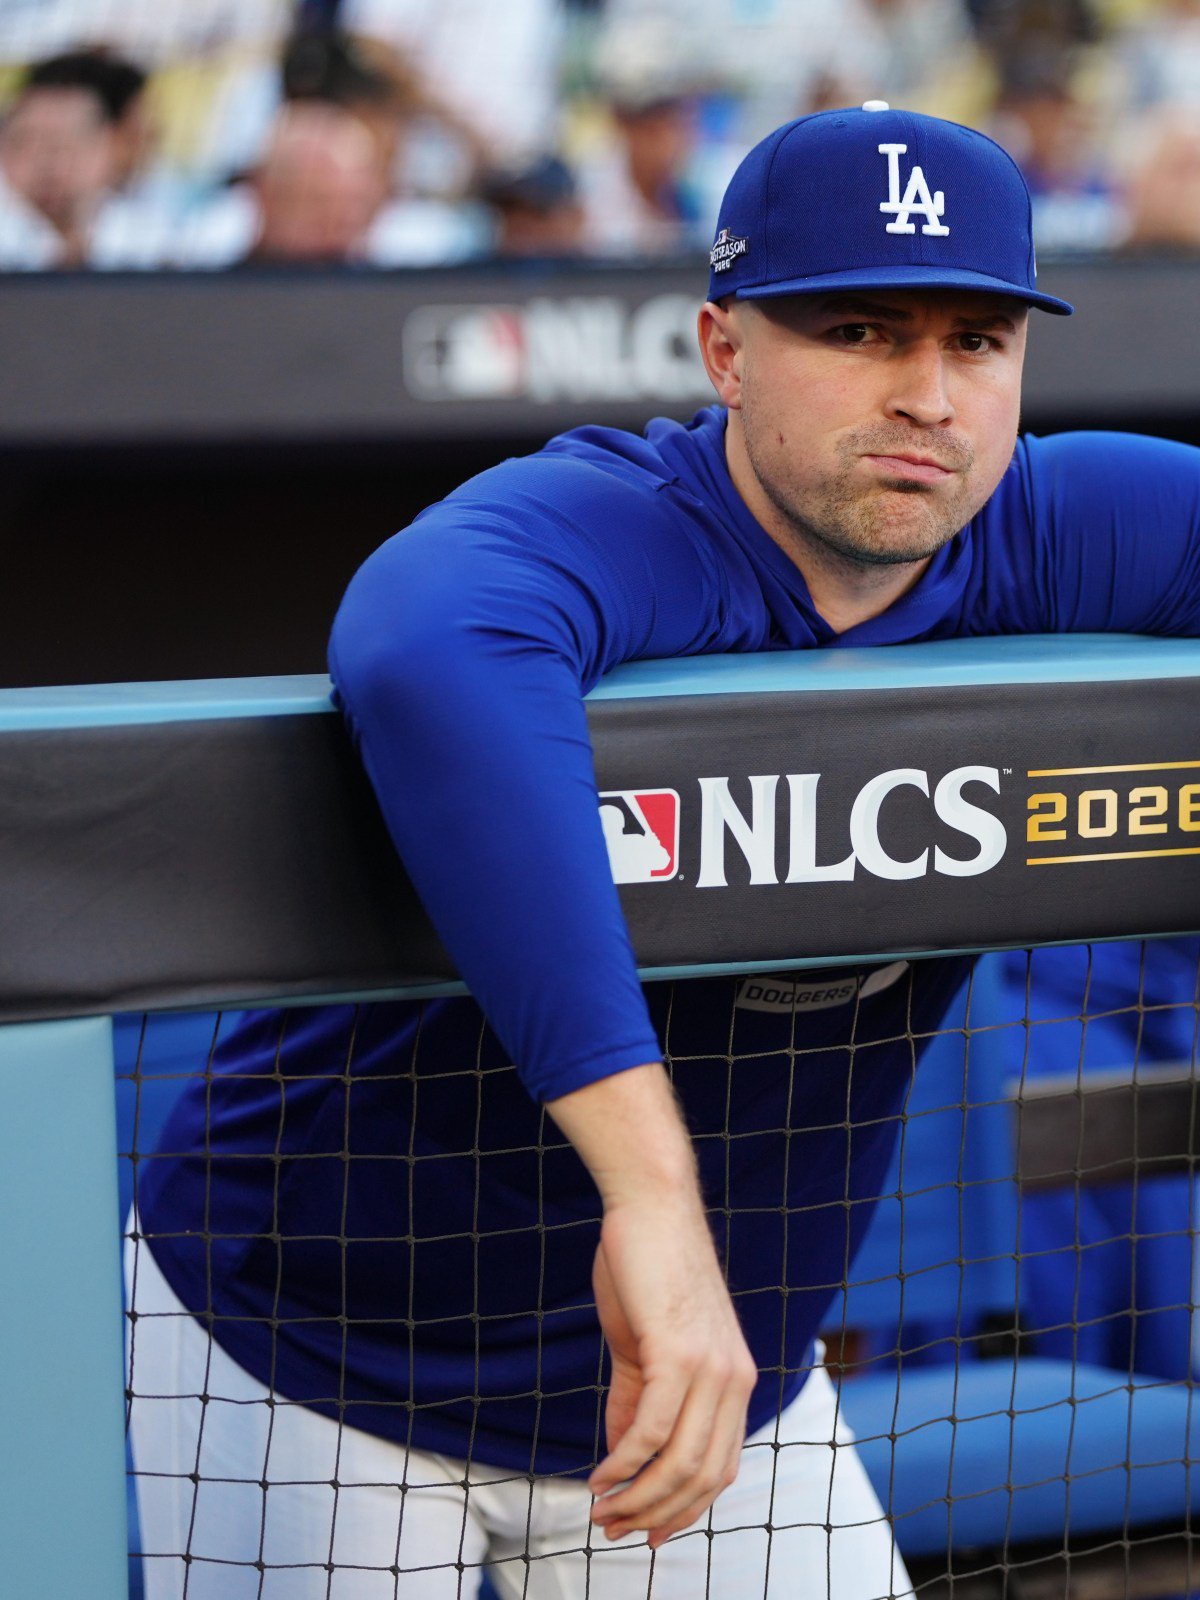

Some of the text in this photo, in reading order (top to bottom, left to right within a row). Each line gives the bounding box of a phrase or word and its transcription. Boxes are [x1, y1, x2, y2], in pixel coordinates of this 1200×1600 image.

[878, 143, 950, 236] LA
[710, 240, 746, 264] OSTSEASON
[695, 765, 1007, 888] NLCS
[745, 985, 855, 1004] DODGERS
